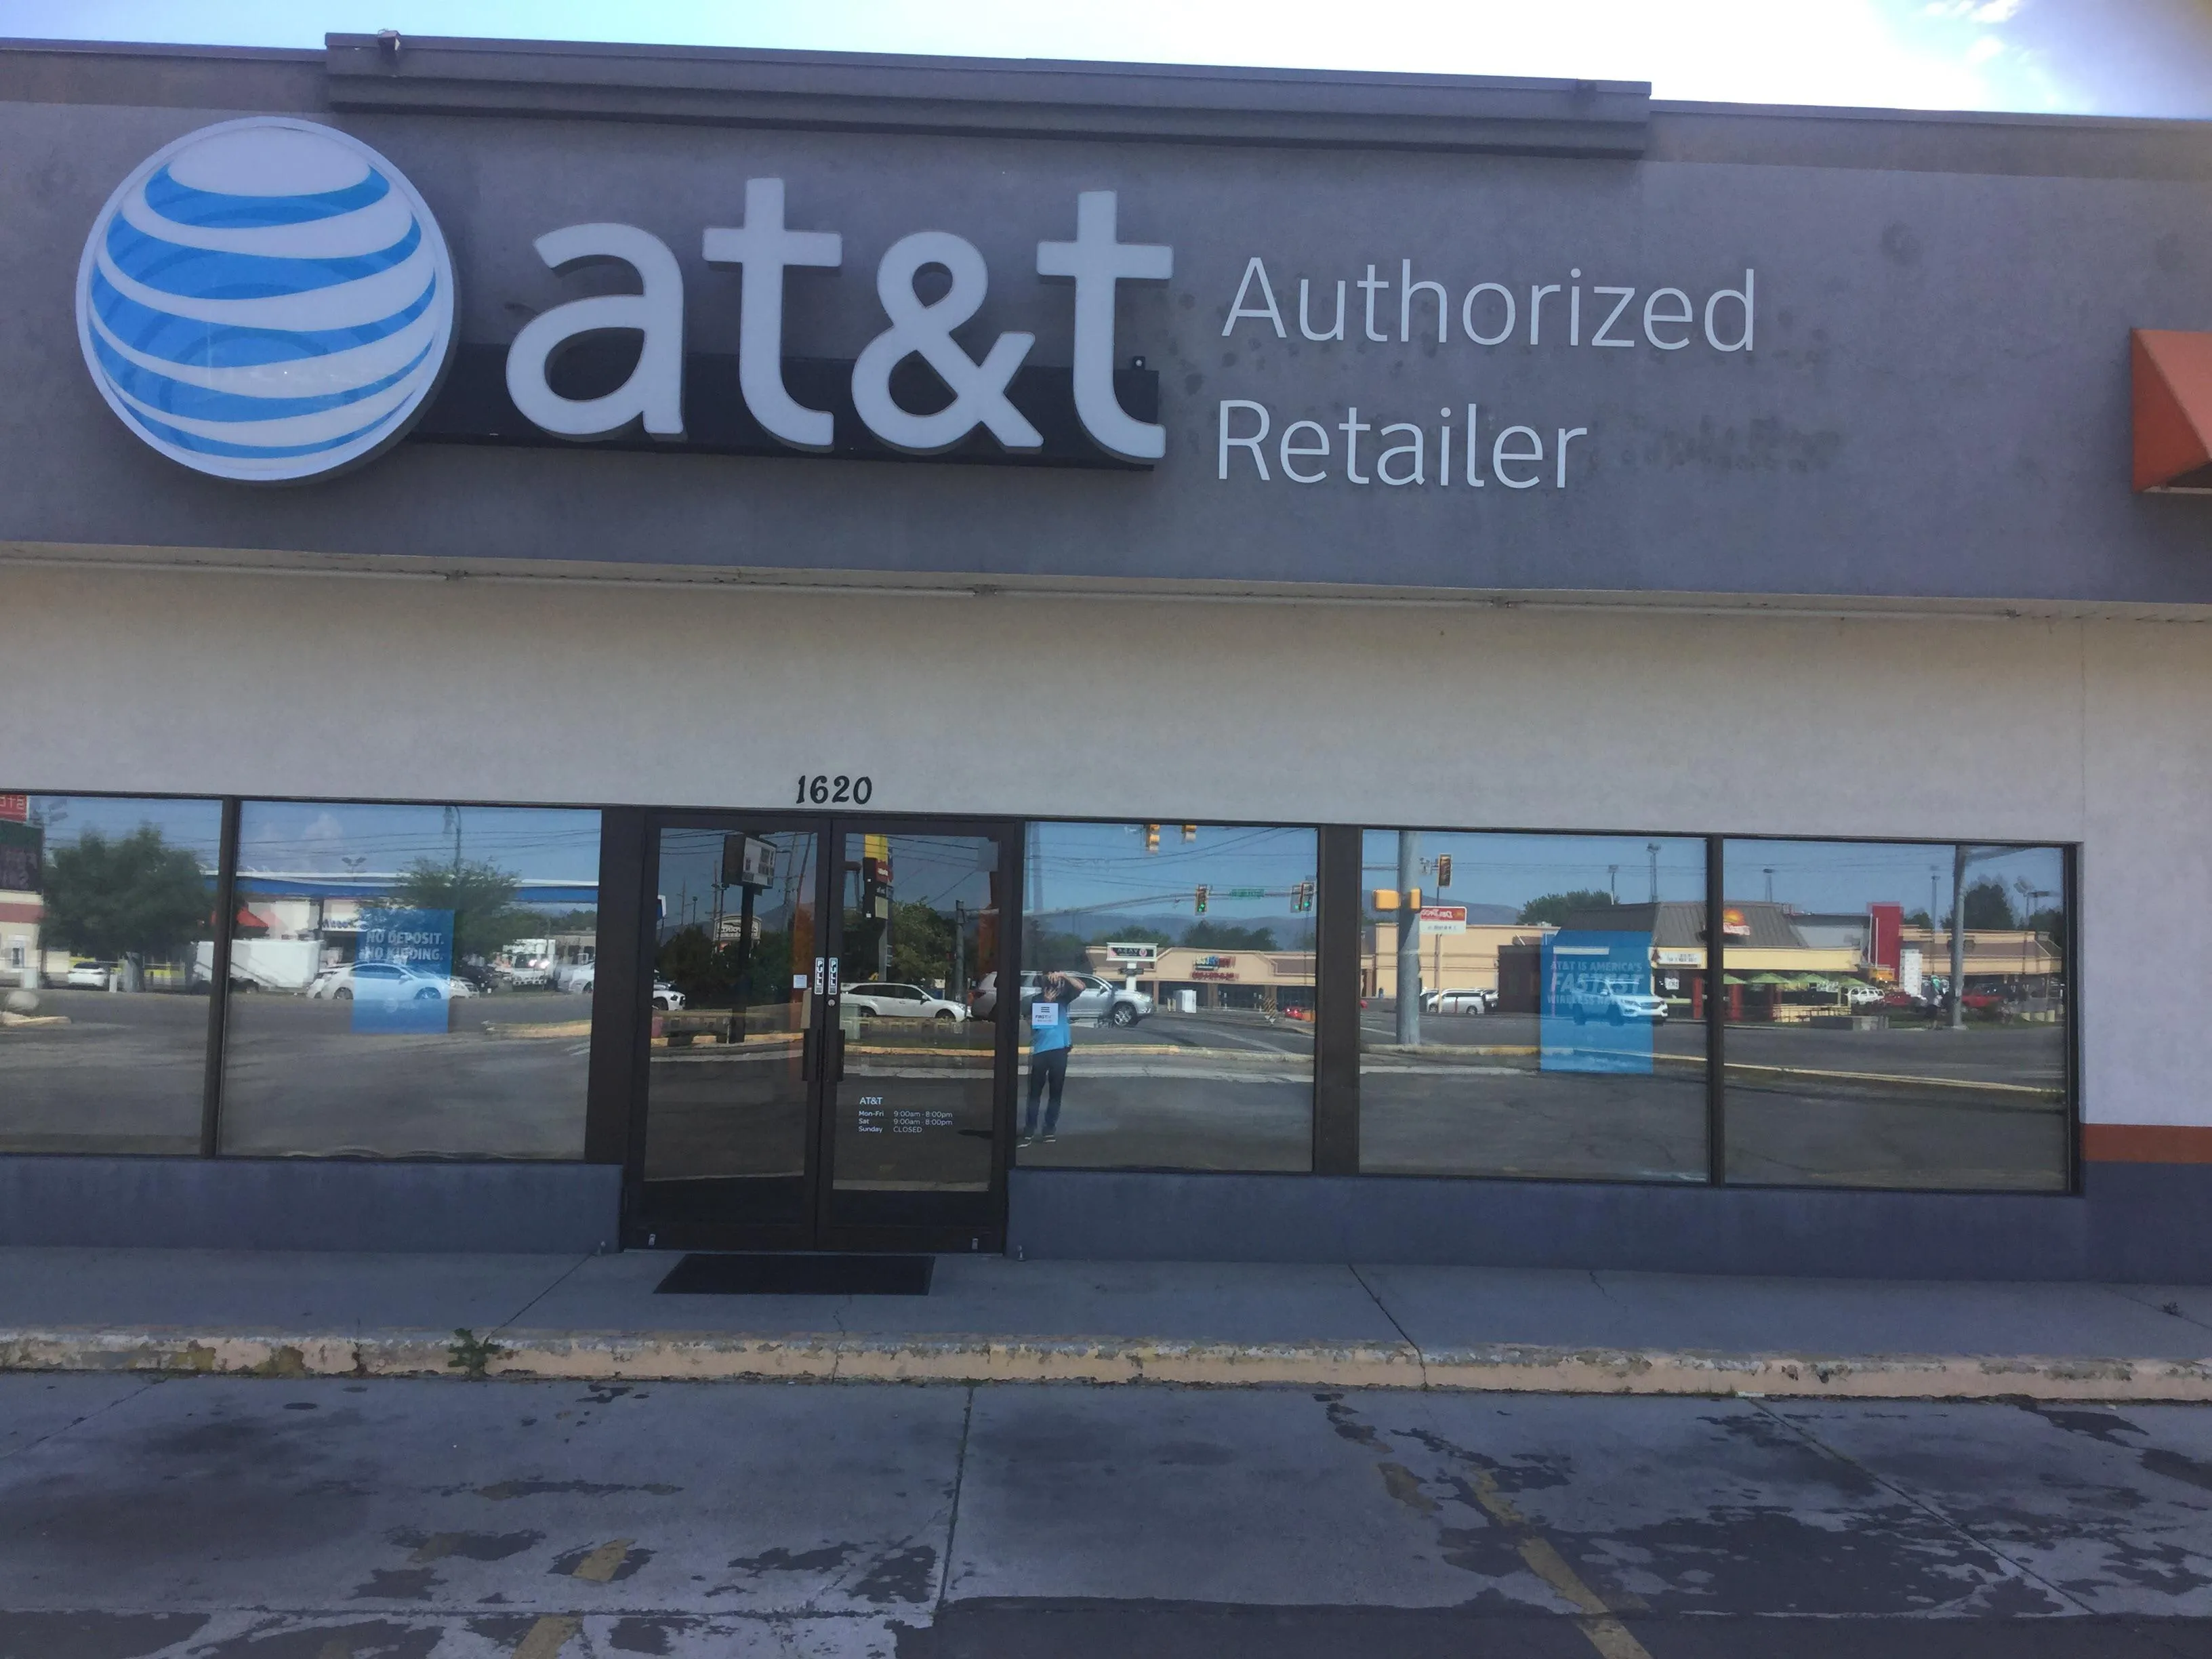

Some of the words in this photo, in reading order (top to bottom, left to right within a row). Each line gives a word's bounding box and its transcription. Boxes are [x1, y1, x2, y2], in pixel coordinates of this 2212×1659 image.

[506, 178, 1174, 460] at&t
[1221, 257, 1754, 352] Authorized
[1218, 400, 1587, 488] Retailer
[796, 775, 872, 804] 1620
[366, 930, 384, 943] NO
[388, 930, 444, 945] DEPOSIT.
[1589, 962, 1642, 972] AMERICA'S
